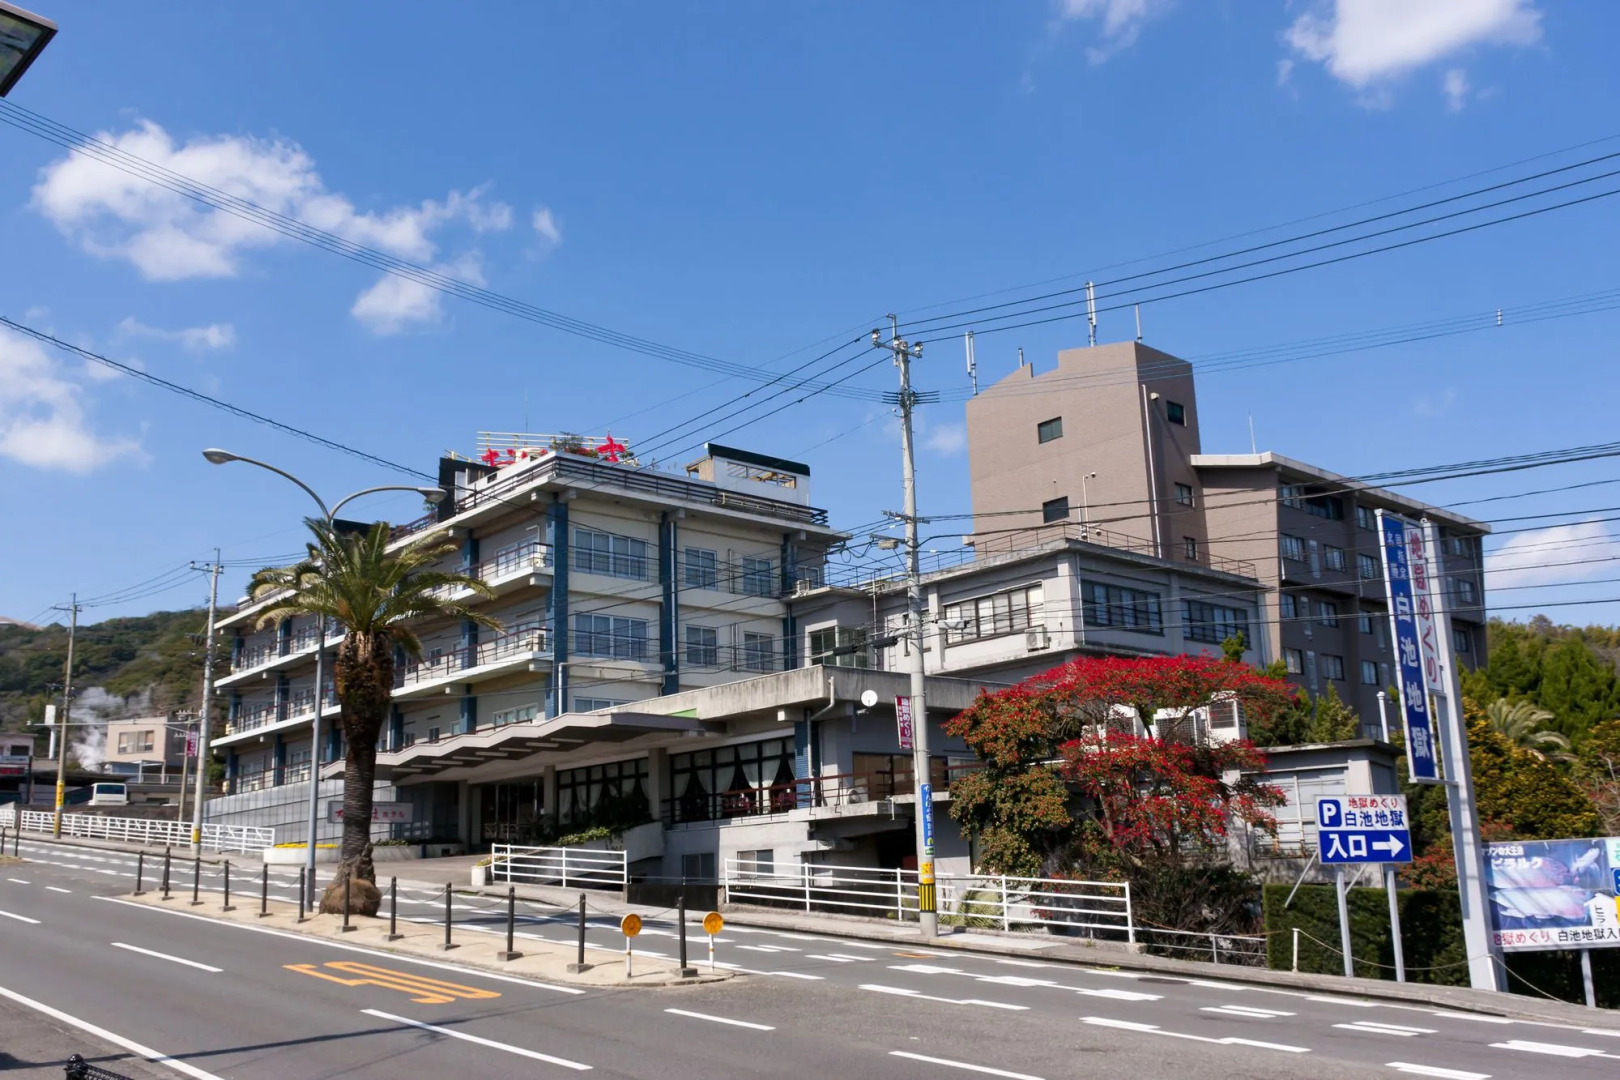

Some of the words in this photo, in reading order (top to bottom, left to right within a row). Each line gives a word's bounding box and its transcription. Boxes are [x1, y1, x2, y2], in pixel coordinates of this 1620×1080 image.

[1409, 530, 1438, 684] 地獄めぐり
[1395, 591, 1431, 760] 白池地獄
[1322, 803, 1337, 824] P
[1348, 797, 1398, 809] 地獄めぐり
[1344, 809, 1405, 828] 白池地獄
[1326, 833, 1368, 859] 入口
[1558, 927, 1620, 943] 白池地獄入
